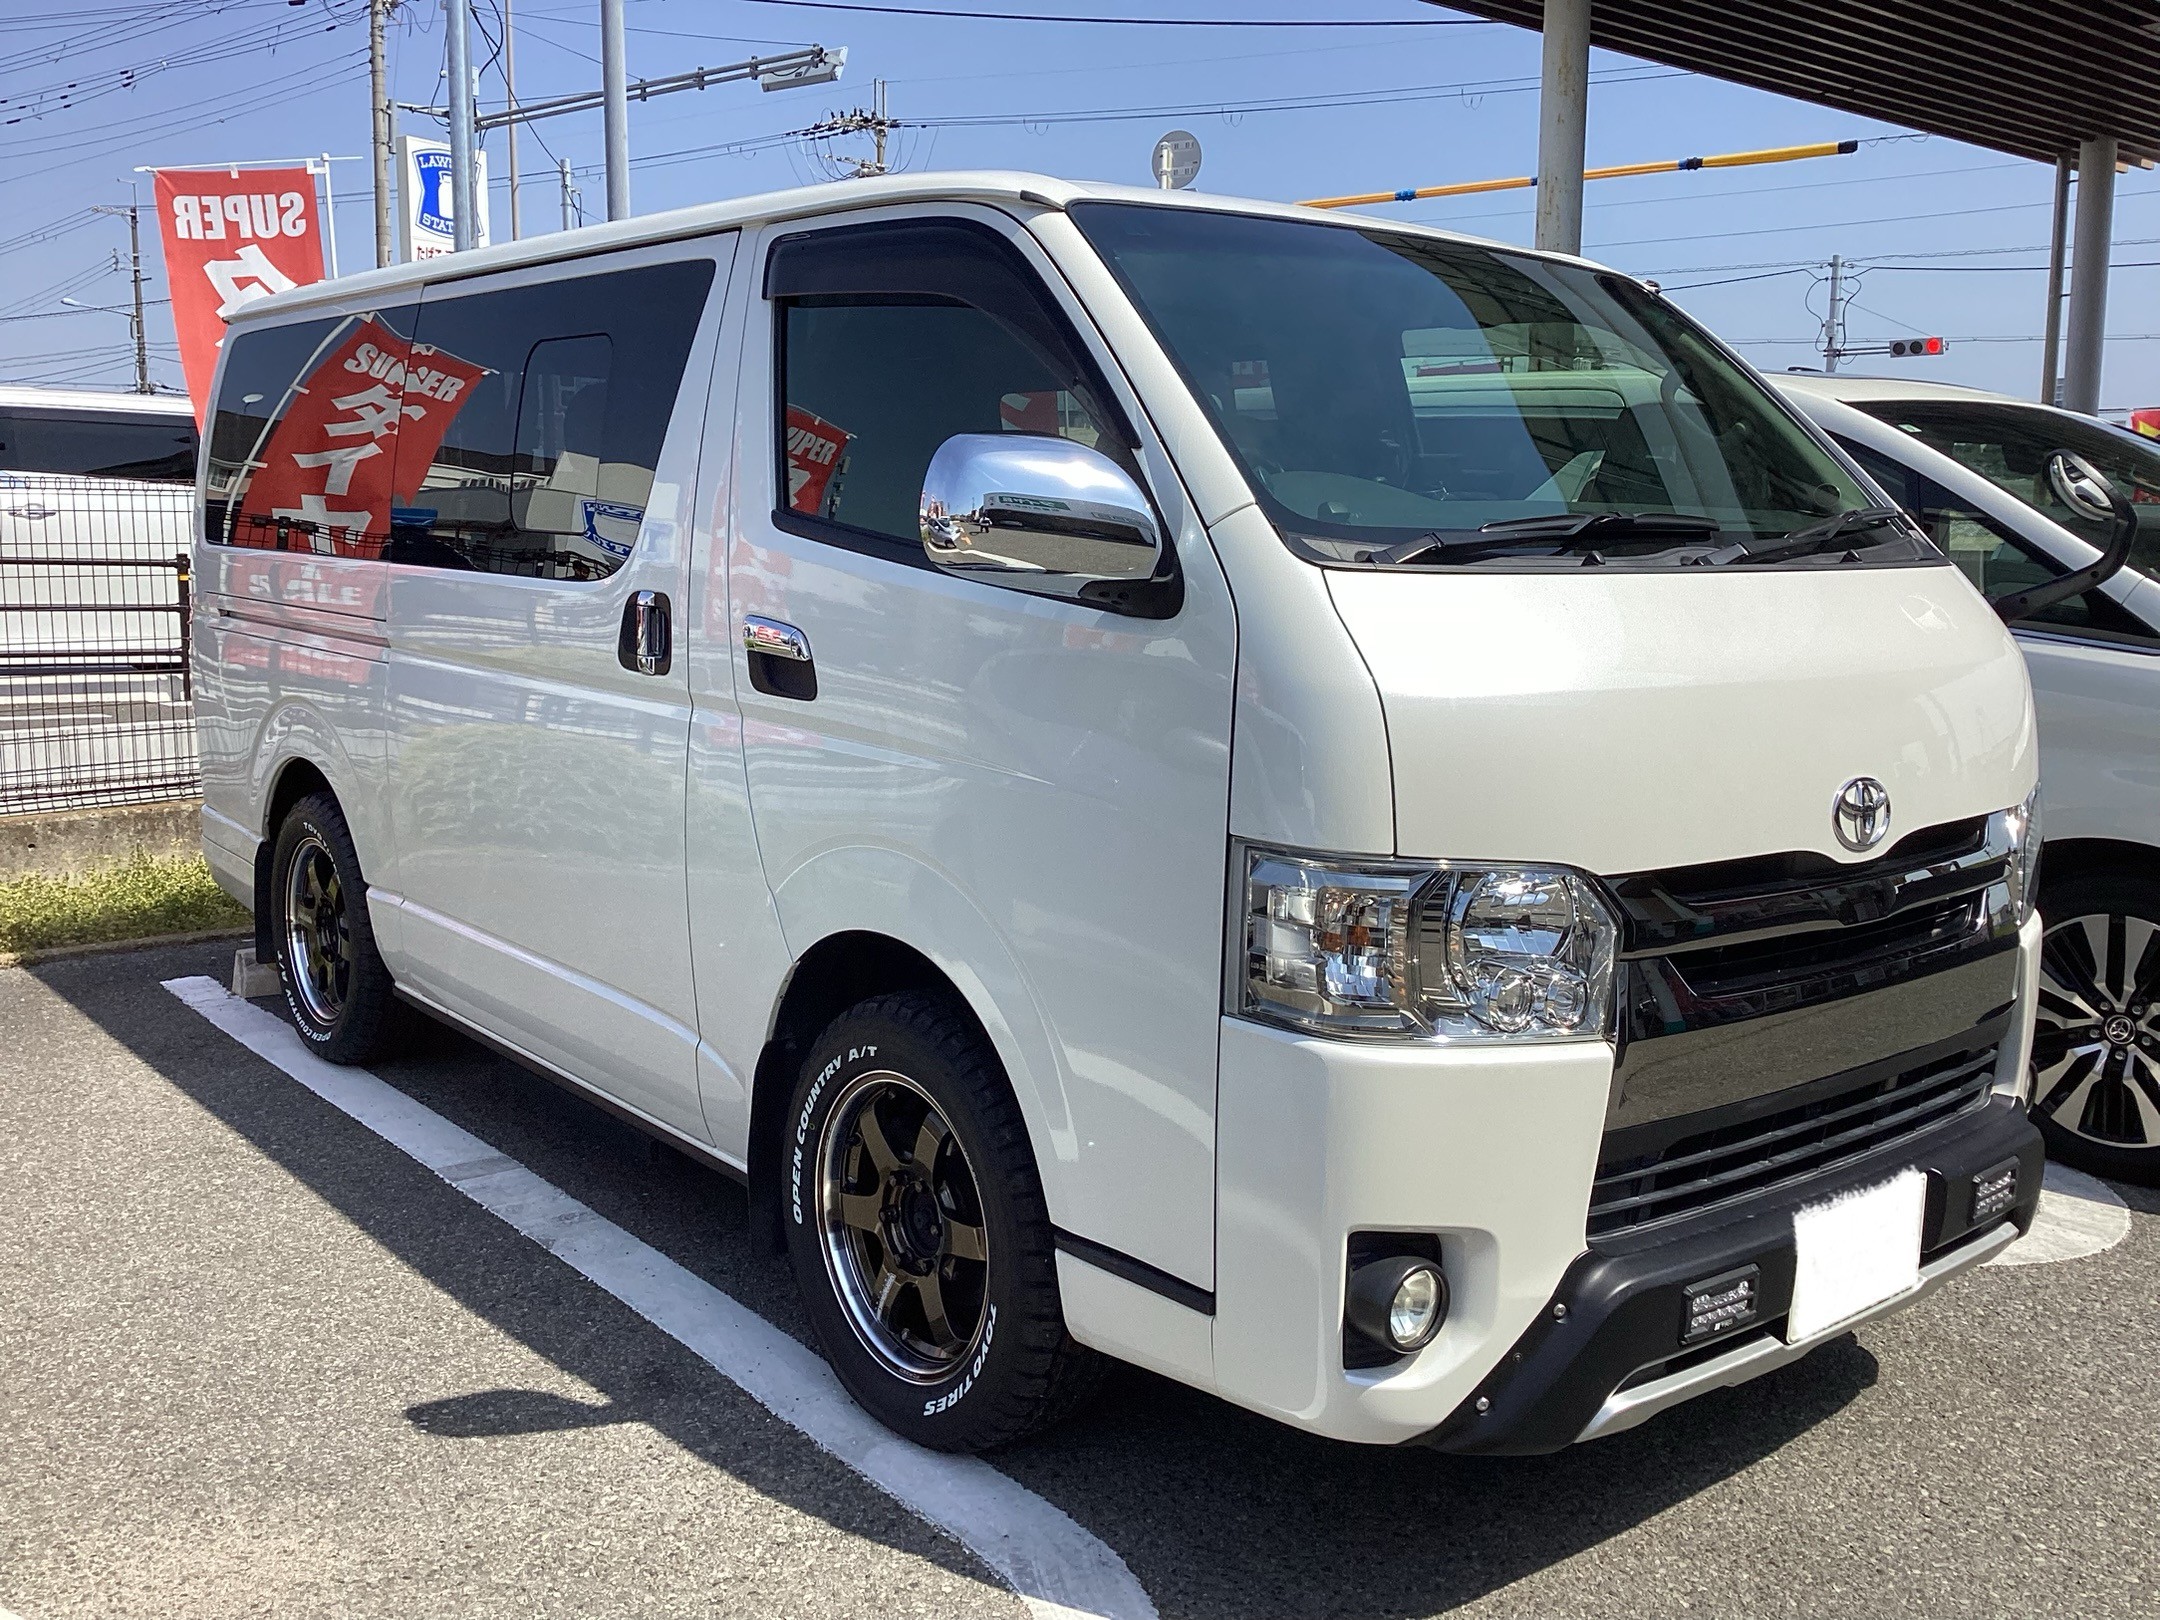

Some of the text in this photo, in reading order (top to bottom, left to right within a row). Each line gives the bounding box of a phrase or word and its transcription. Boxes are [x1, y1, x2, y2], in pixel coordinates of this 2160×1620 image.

[418, 155, 452, 169] LAW
[285, 988, 313, 1037] COUNTRY
[792, 1045, 878, 1225] OPEN COUNTRY A/T
[923, 1303, 997, 1416] TOYO TIRES
